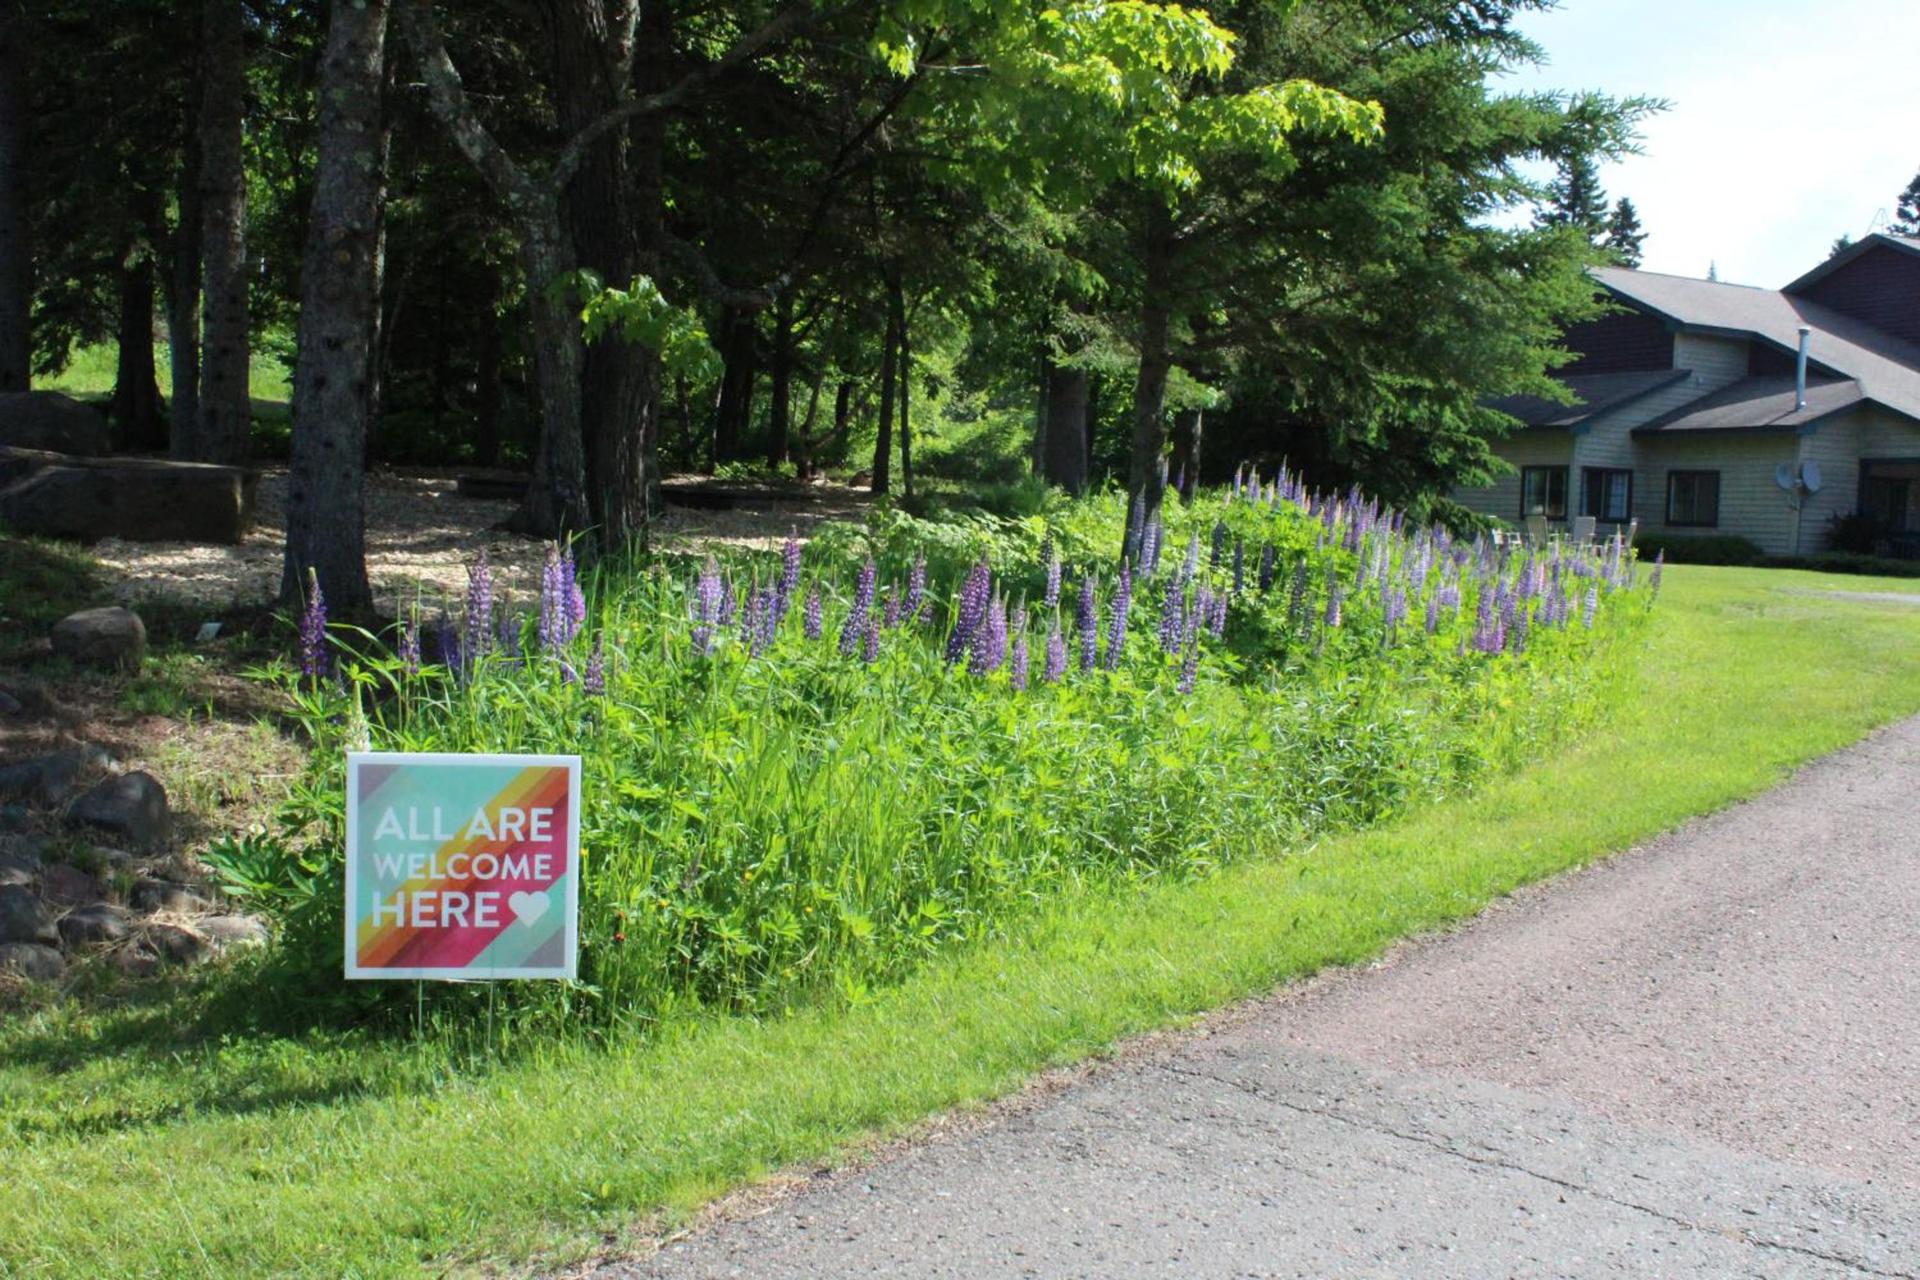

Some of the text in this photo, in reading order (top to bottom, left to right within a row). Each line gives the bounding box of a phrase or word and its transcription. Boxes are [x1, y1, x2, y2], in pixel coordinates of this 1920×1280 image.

[373, 806, 553, 842] ALL ARE
[372, 853, 552, 880] WELCOME
[372, 891, 500, 927] HERE
